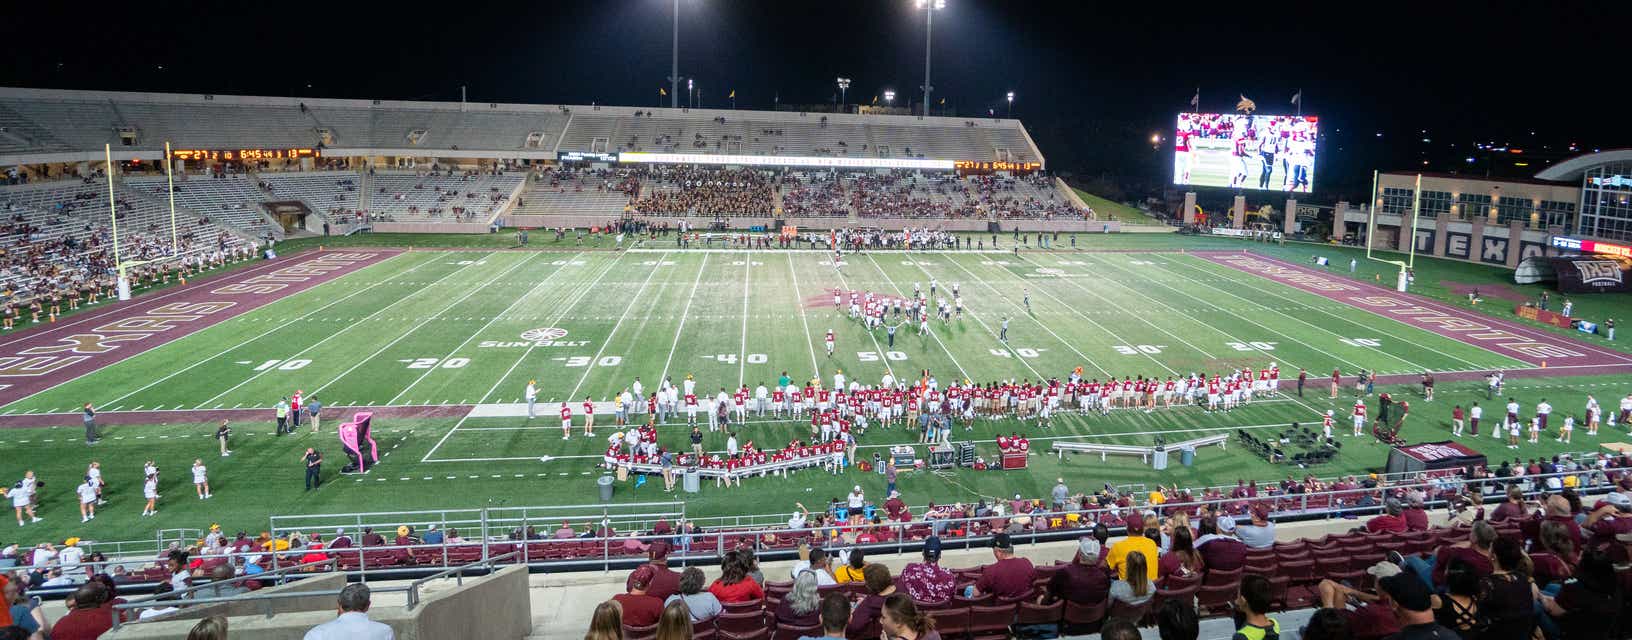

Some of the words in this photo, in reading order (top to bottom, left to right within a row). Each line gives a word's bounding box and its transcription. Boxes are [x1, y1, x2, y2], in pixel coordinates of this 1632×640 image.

[193, 149, 208, 159] 27
[224, 151, 232, 160] 10
[240, 149, 261, 159] 6:45
[287, 149, 298, 159] 13
[209, 252, 380, 295] STATE
[1348, 296, 1585, 359] STATE
[478, 340, 530, 348] SUN
[717, 353, 768, 364] 40
[857, 351, 908, 362] 50
[989, 348, 1040, 358] 40
[253, 359, 313, 371] 10
[406, 358, 471, 369] 20
[565, 356, 623, 367] 30
